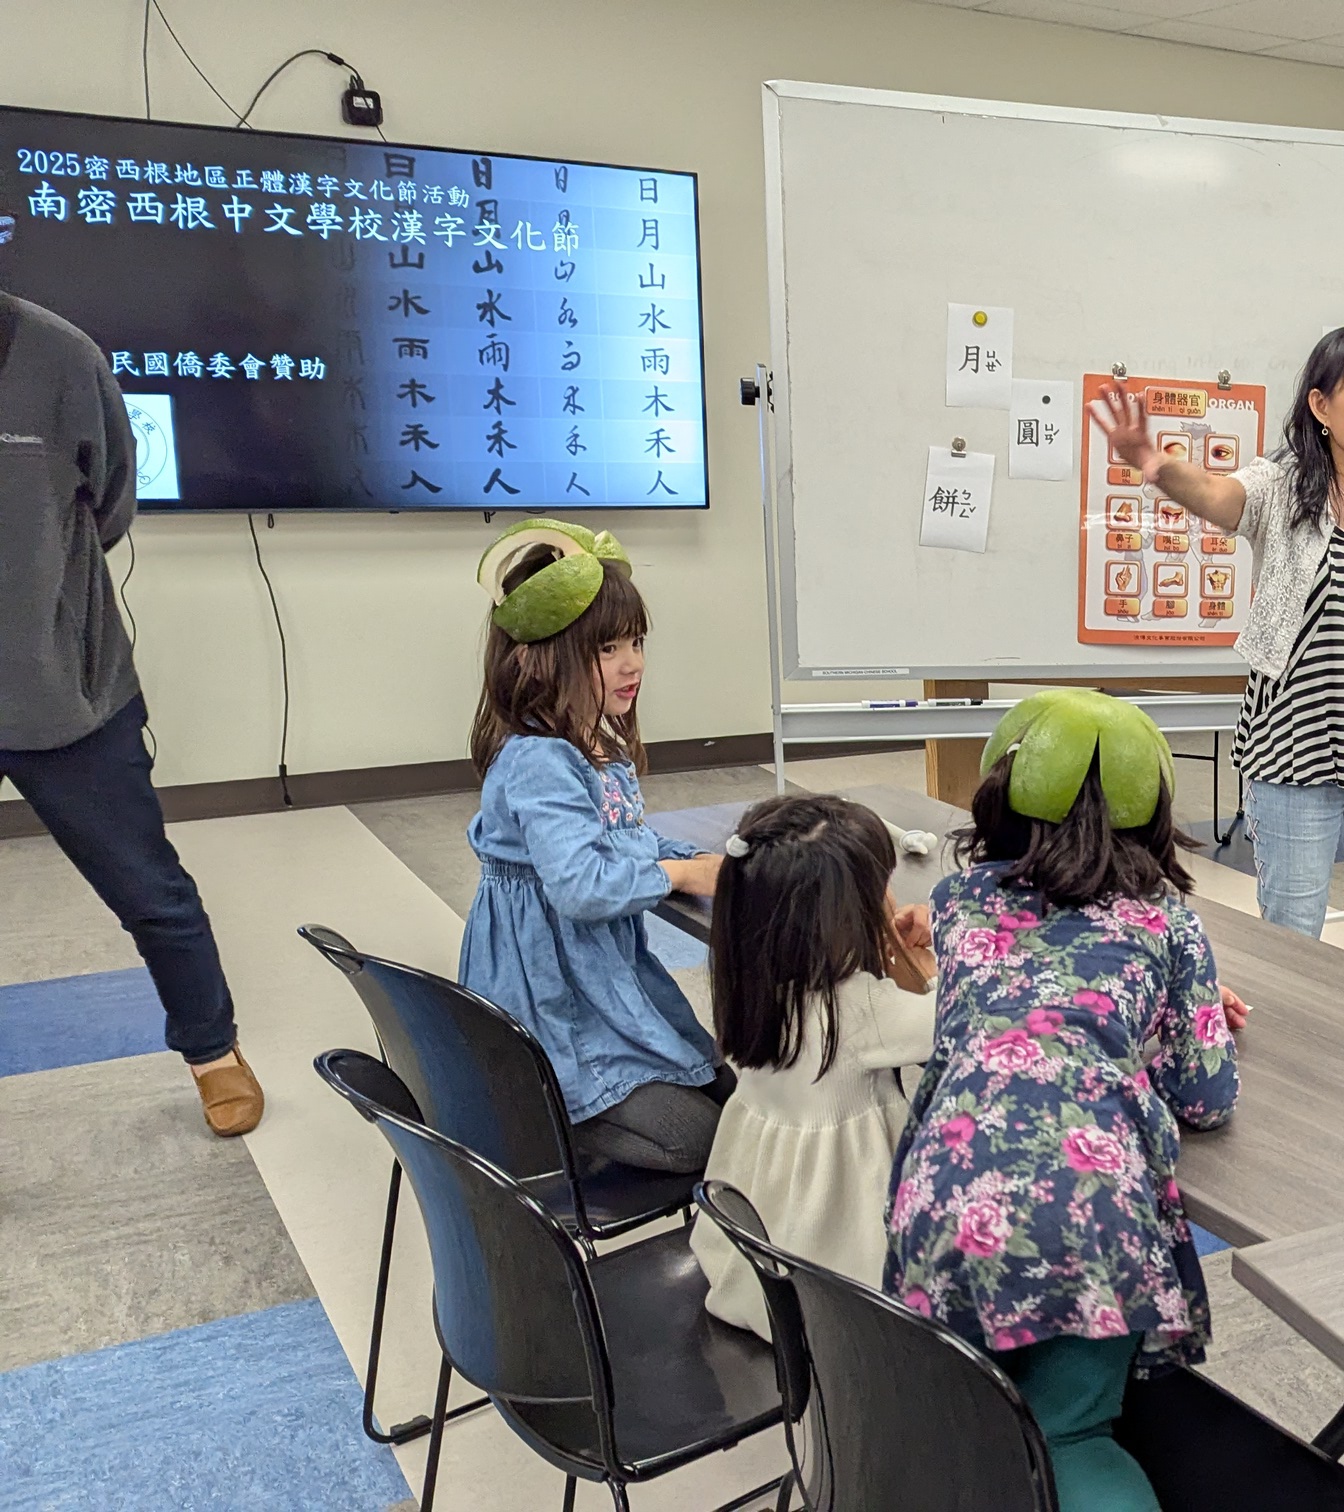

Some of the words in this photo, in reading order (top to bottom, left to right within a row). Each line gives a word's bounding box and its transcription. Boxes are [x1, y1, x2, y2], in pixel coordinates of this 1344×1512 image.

[17, 149, 470, 208] 2025密西根地區正體漢字文化節活動
[27, 180, 580, 256] 南密西根中文學校漢字文化節
[111, 350, 326, 381] 民國僑委會贊助
[958, 345, 981, 374] 月
[1152, 391, 1201, 408] 身體器官
[1208, 397, 1255, 411] ORGAN
[1016, 418, 1040, 447] 圓
[928, 486, 960, 517] 餅
[1118, 599, 1128, 608] 手
